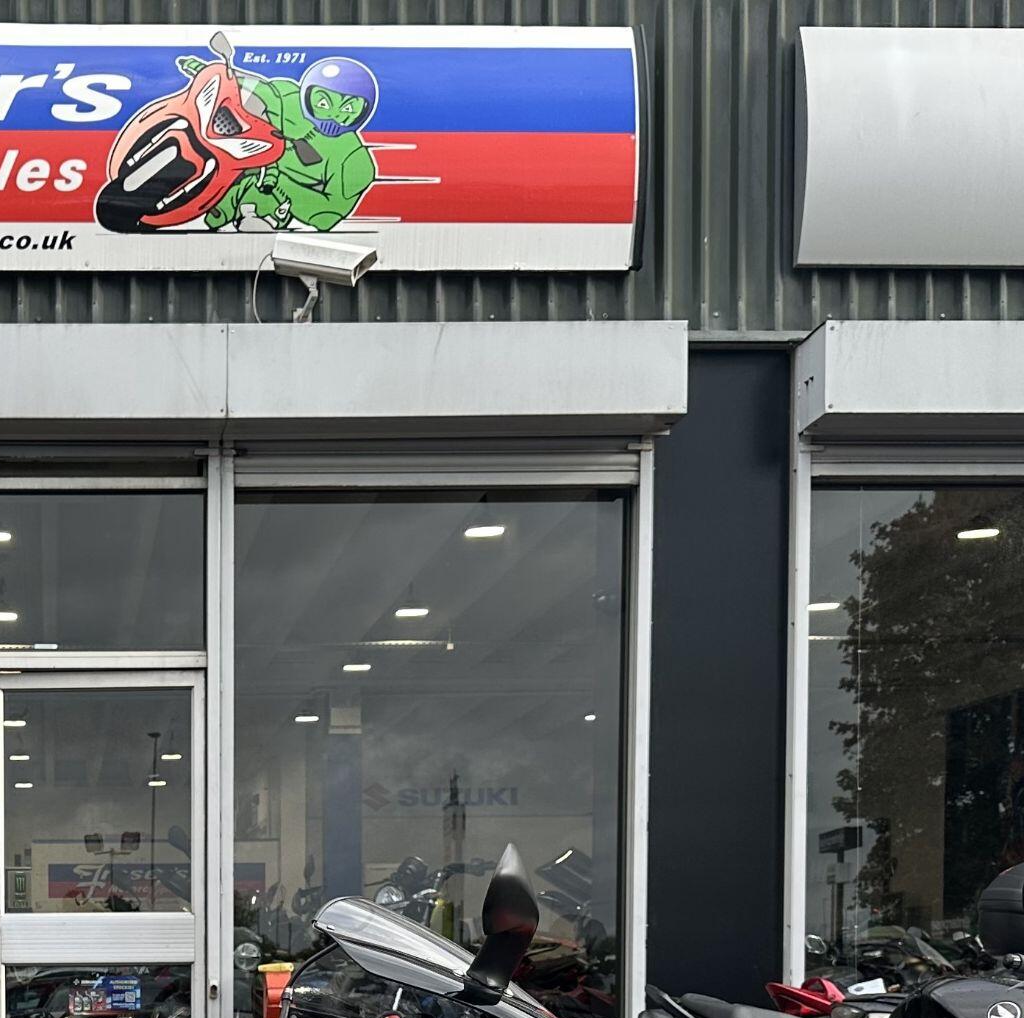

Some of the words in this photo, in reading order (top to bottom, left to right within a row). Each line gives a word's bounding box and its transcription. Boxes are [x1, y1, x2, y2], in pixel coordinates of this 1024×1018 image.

[243, 52, 270, 63] Est.
[276, 52, 306, 64] 1971
[399, 786, 518, 806] SUZUKI
